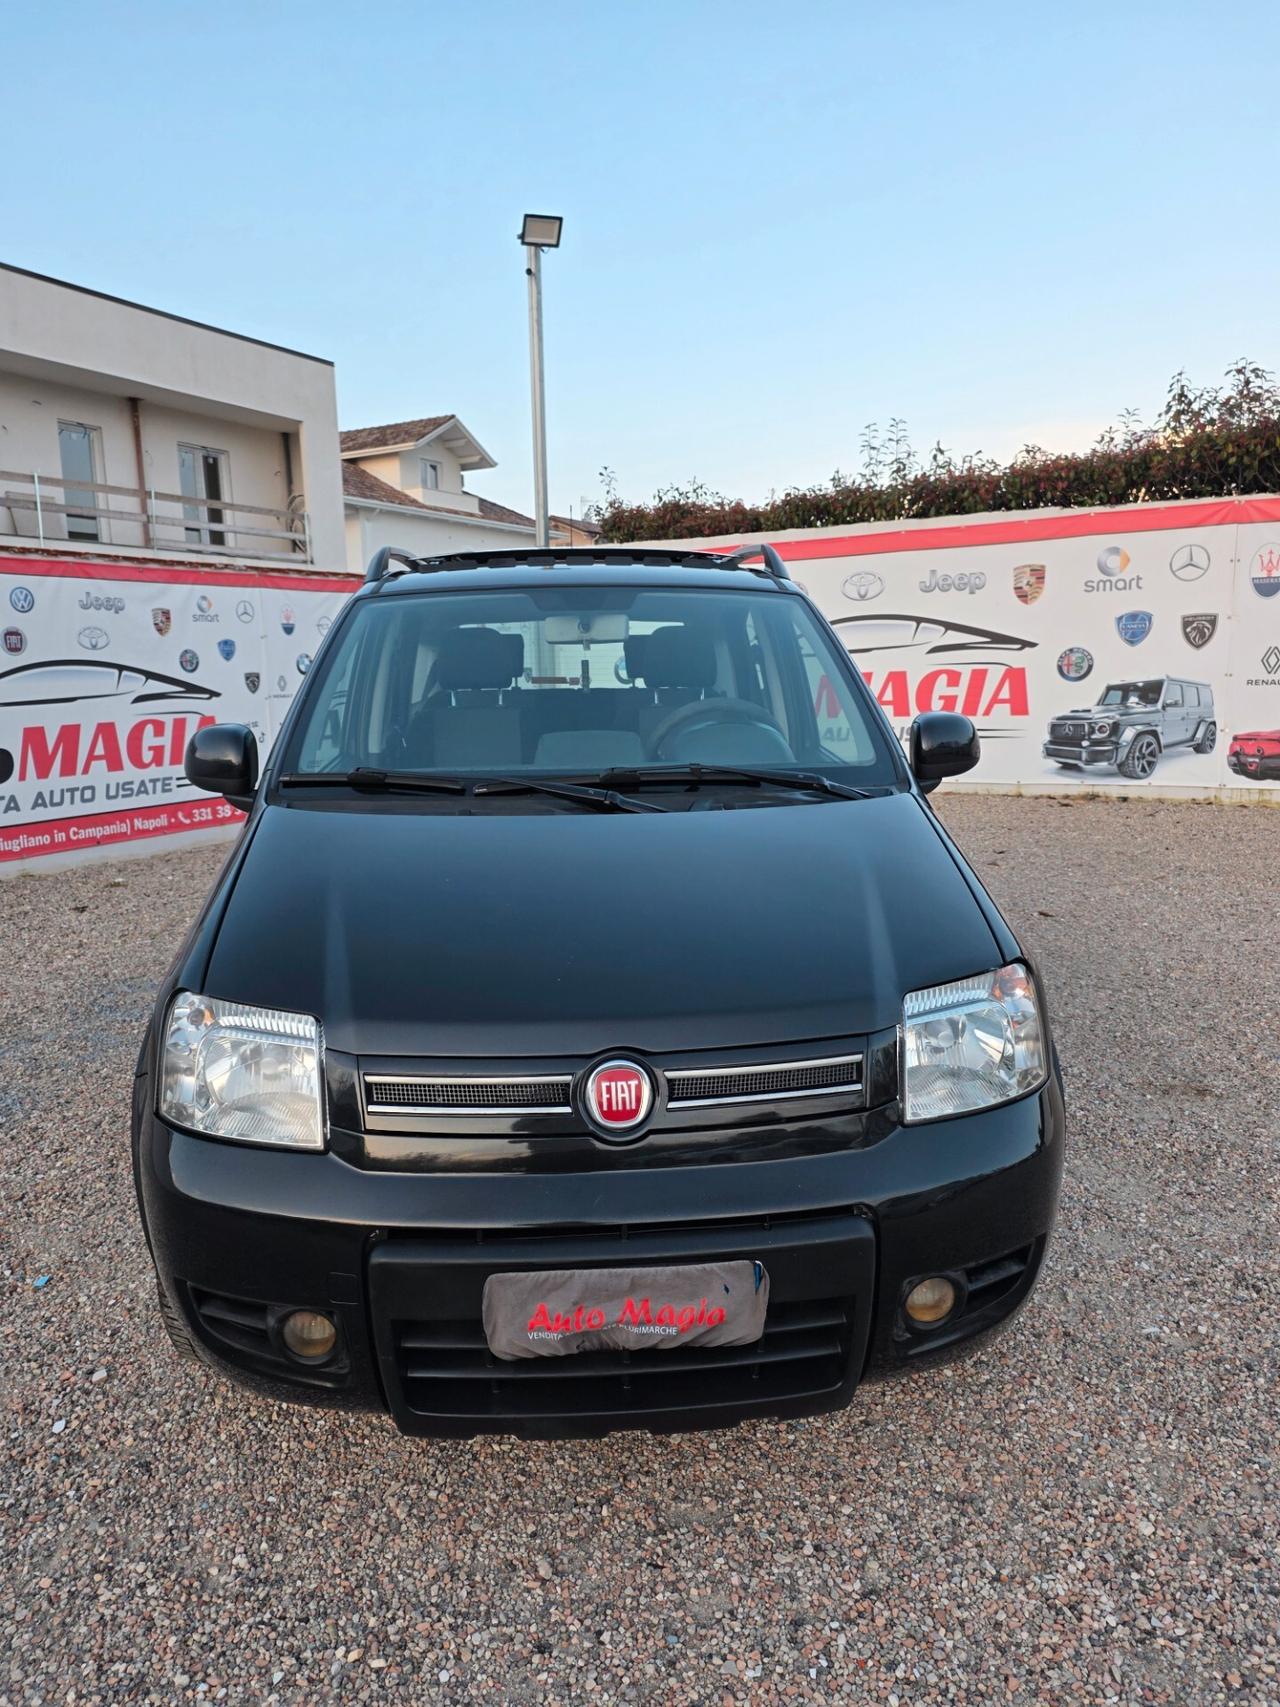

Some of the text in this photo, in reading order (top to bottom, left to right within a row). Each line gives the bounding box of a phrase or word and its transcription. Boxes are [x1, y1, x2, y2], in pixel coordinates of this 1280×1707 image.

[919, 569, 987, 595] Jeep
[1083, 575, 1143, 592] smart
[78, 591, 126, 614] Jeep
[192, 613, 219, 623] smart
[6, 635, 22, 648] FIAT
[31, 784, 96, 810] AUTO
[105, 776, 174, 800] USATE
[54, 830, 66, 843] in
[69, 818, 131, 839] Campania)
[134, 814, 168, 831] Napoli
[192, 807, 213, 822] 331
[216, 805, 232, 818] 38
[601, 1080, 639, 1111] FIAT
[527, 1297, 727, 1334] Auto Magia
